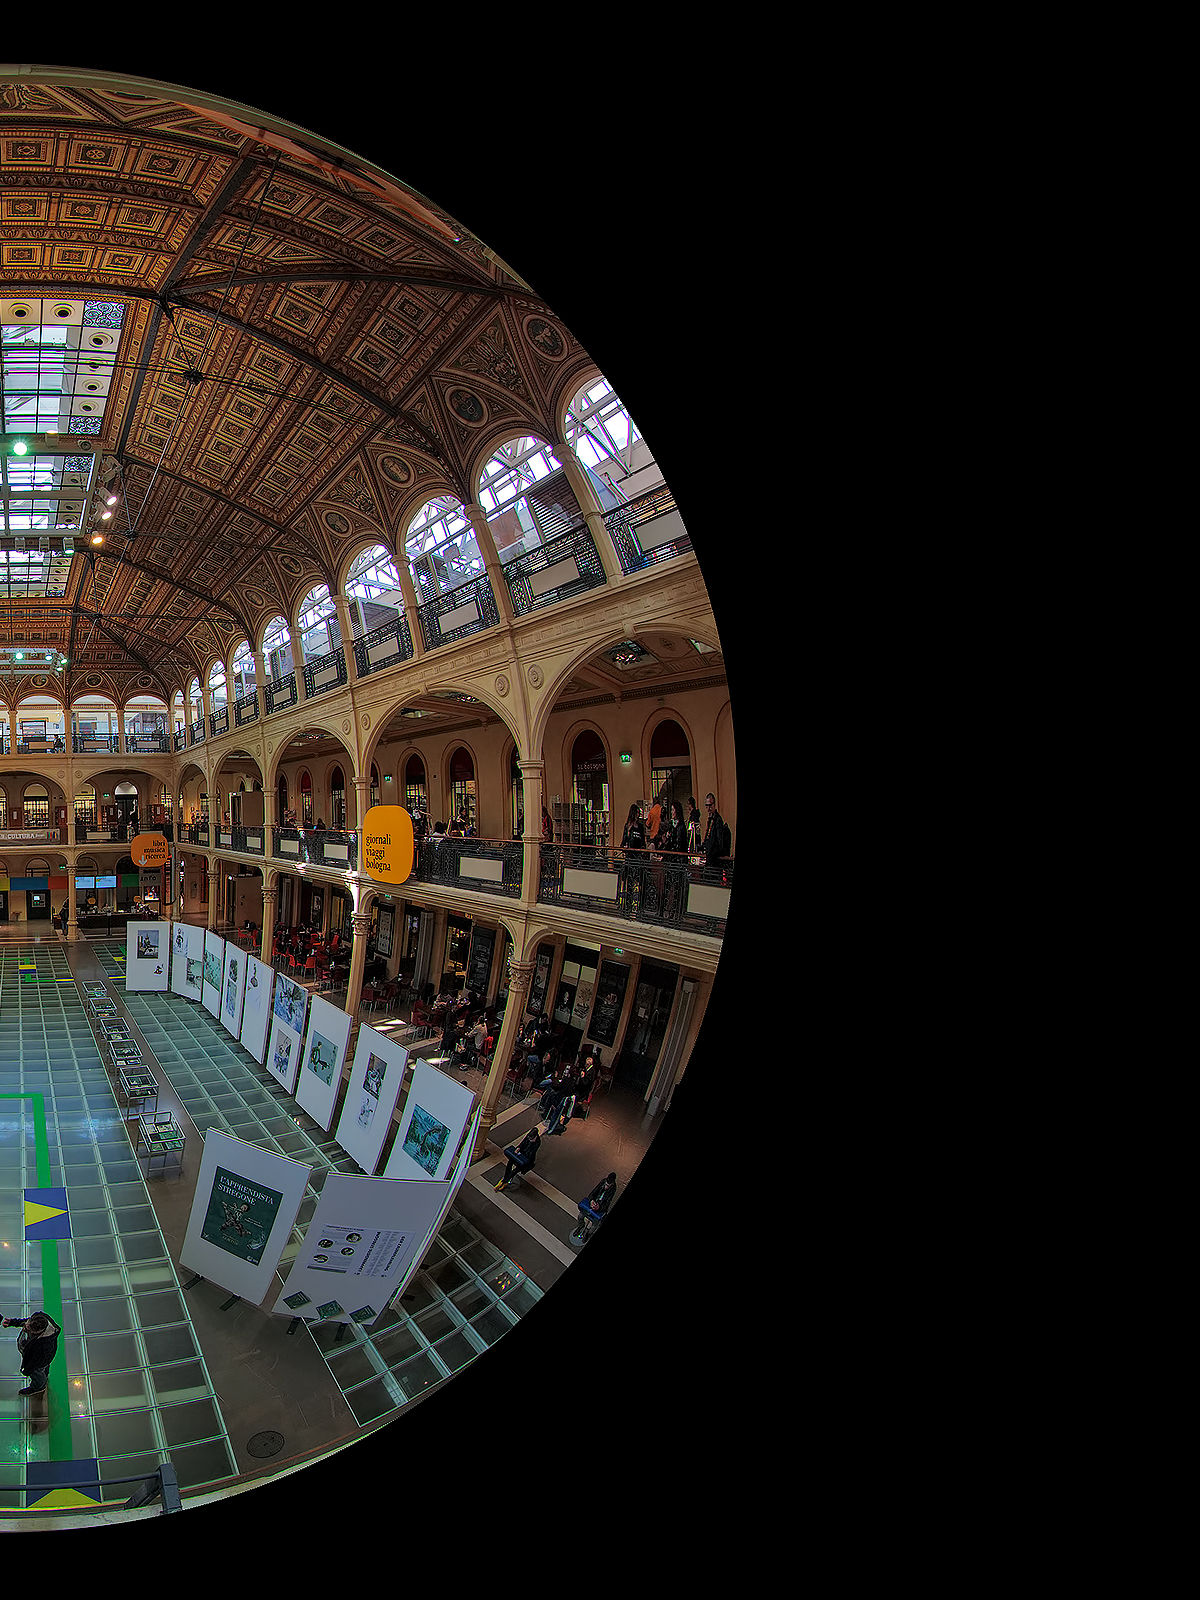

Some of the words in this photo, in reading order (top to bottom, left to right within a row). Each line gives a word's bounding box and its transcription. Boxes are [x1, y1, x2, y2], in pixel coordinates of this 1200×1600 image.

[152, 839, 166, 847] libri
[365, 833, 391, 847] giornali
[365, 846, 385, 860] viaggi
[365, 857, 392, 873] bologna
[217, 1183, 257, 1206] STREGONE
[220, 1176, 274, 1205] L'APPRENDISTA
